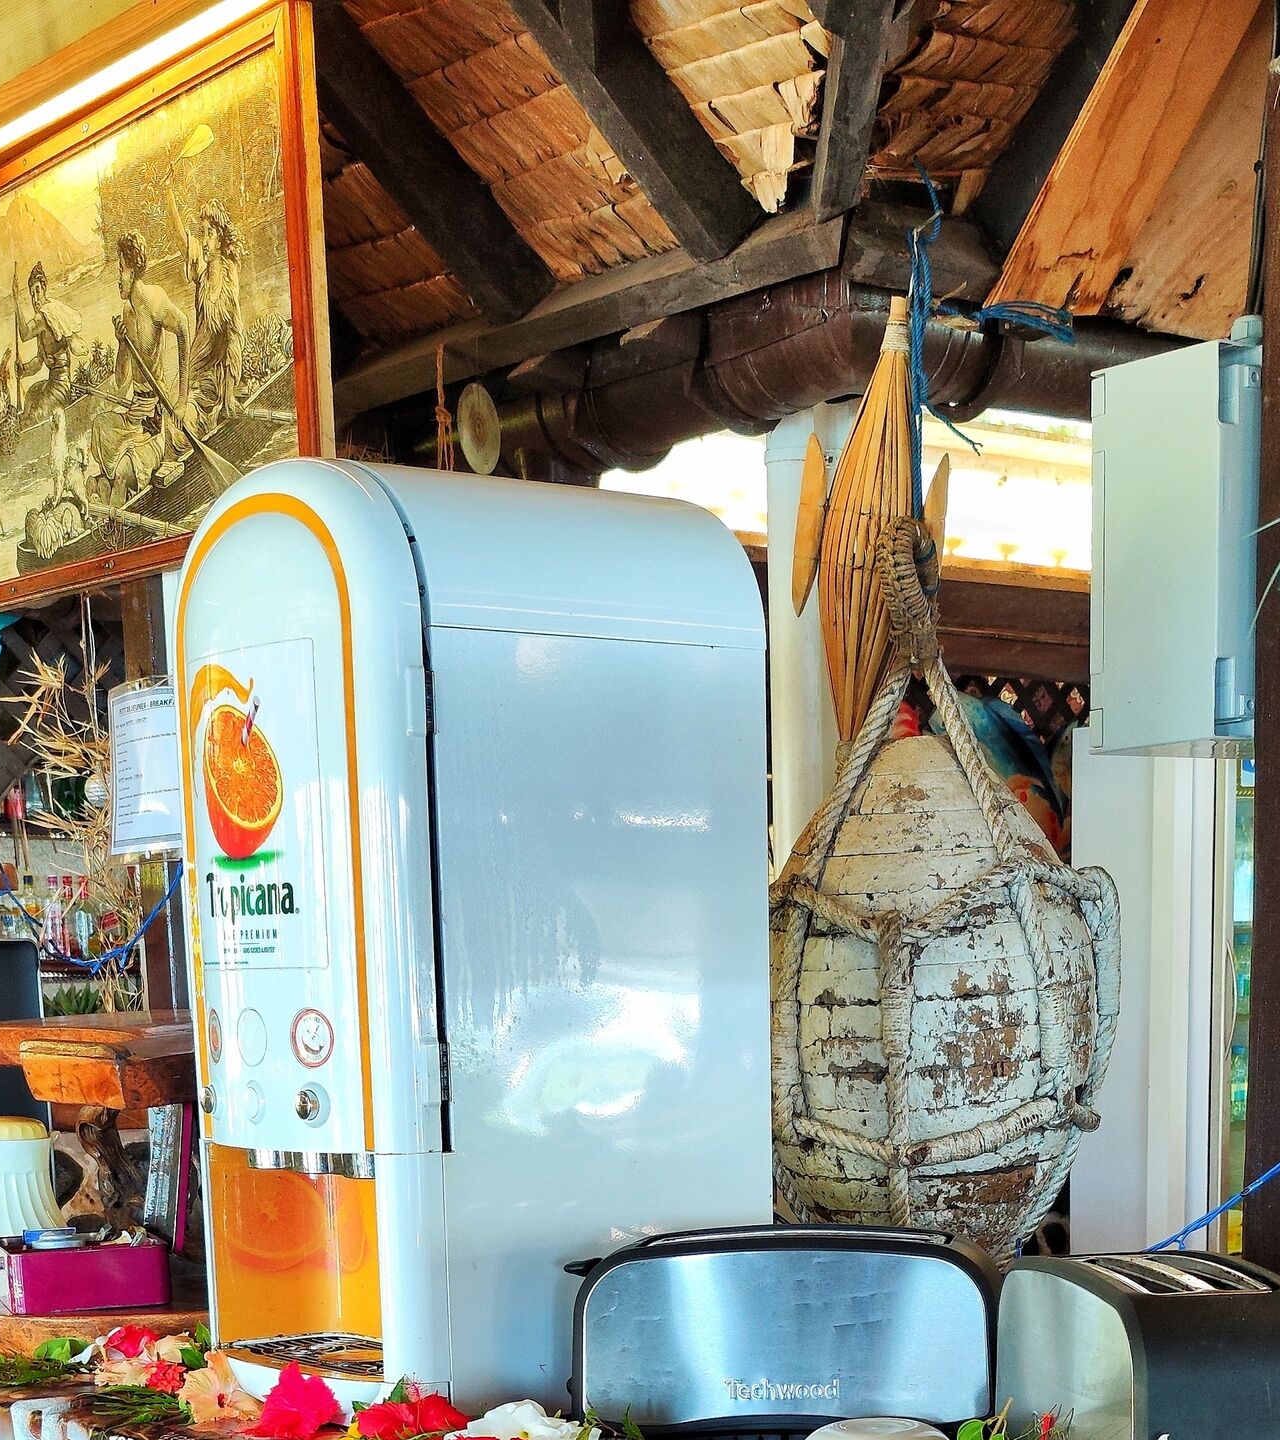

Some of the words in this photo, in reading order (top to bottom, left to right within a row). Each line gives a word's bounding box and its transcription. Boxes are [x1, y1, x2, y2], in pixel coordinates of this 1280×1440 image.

[206, 873, 295, 925] Topicana
[240, 929, 277, 940] PREMIUM
[724, 1378, 840, 1400] Techwood
